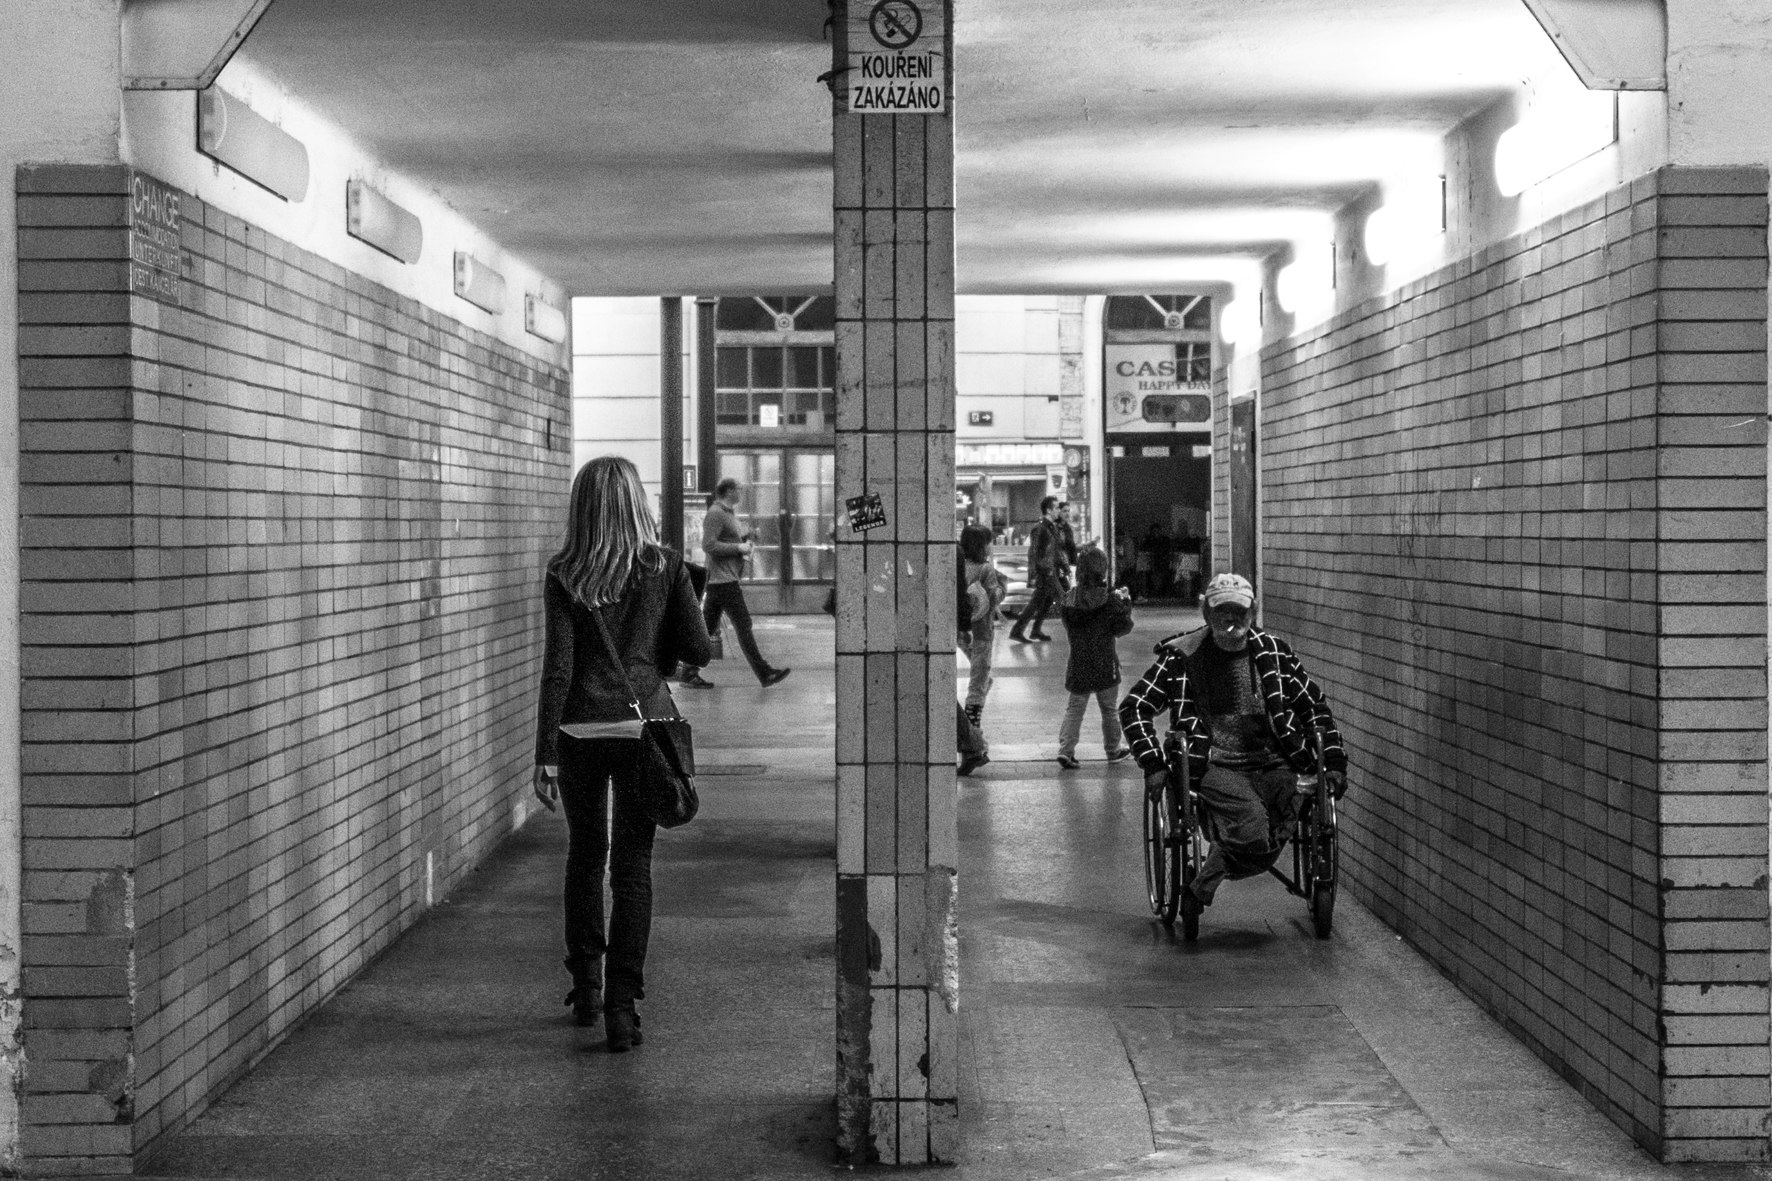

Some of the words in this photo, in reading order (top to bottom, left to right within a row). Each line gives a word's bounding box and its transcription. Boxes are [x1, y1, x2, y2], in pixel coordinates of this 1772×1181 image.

[862, 50, 931, 78] KOUŘENÍ
[854, 81, 940, 108] ZAKÁZÁNO
[133, 176, 179, 230] CHANGE
[1139, 380, 1181, 391] HAPPY
